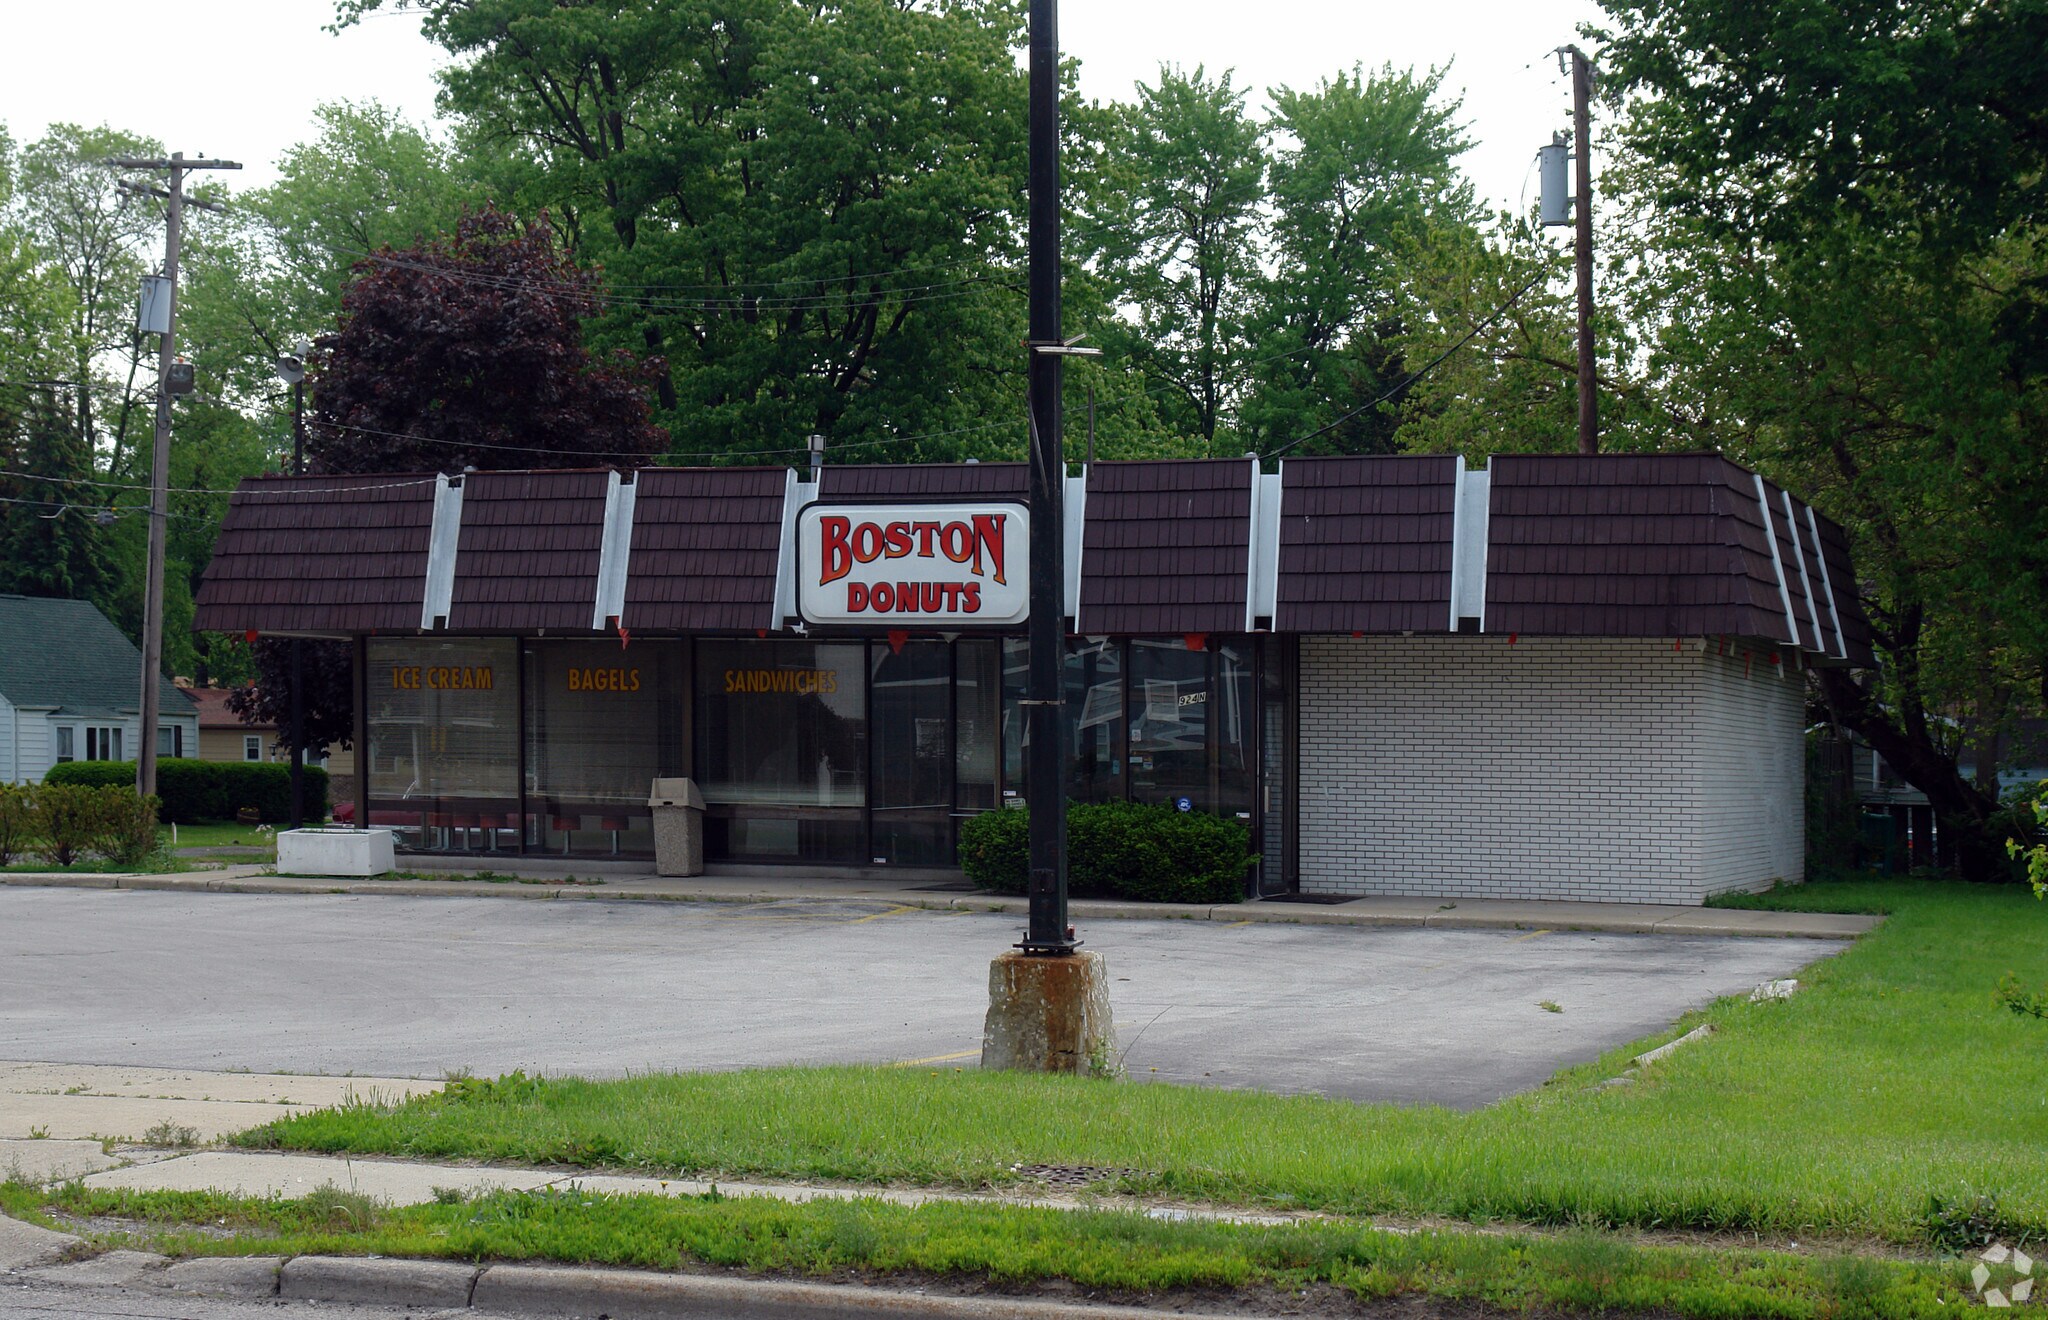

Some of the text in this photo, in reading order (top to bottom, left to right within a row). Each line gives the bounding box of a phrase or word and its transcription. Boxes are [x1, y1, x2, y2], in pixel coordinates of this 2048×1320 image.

[819, 514, 1007, 586] BOSTON
[847, 581, 981, 613] DONUTS
[392, 667, 493, 689] ICE CREAM
[568, 668, 640, 691] BAGELS
[725, 670, 838, 693] SANDWICHES
